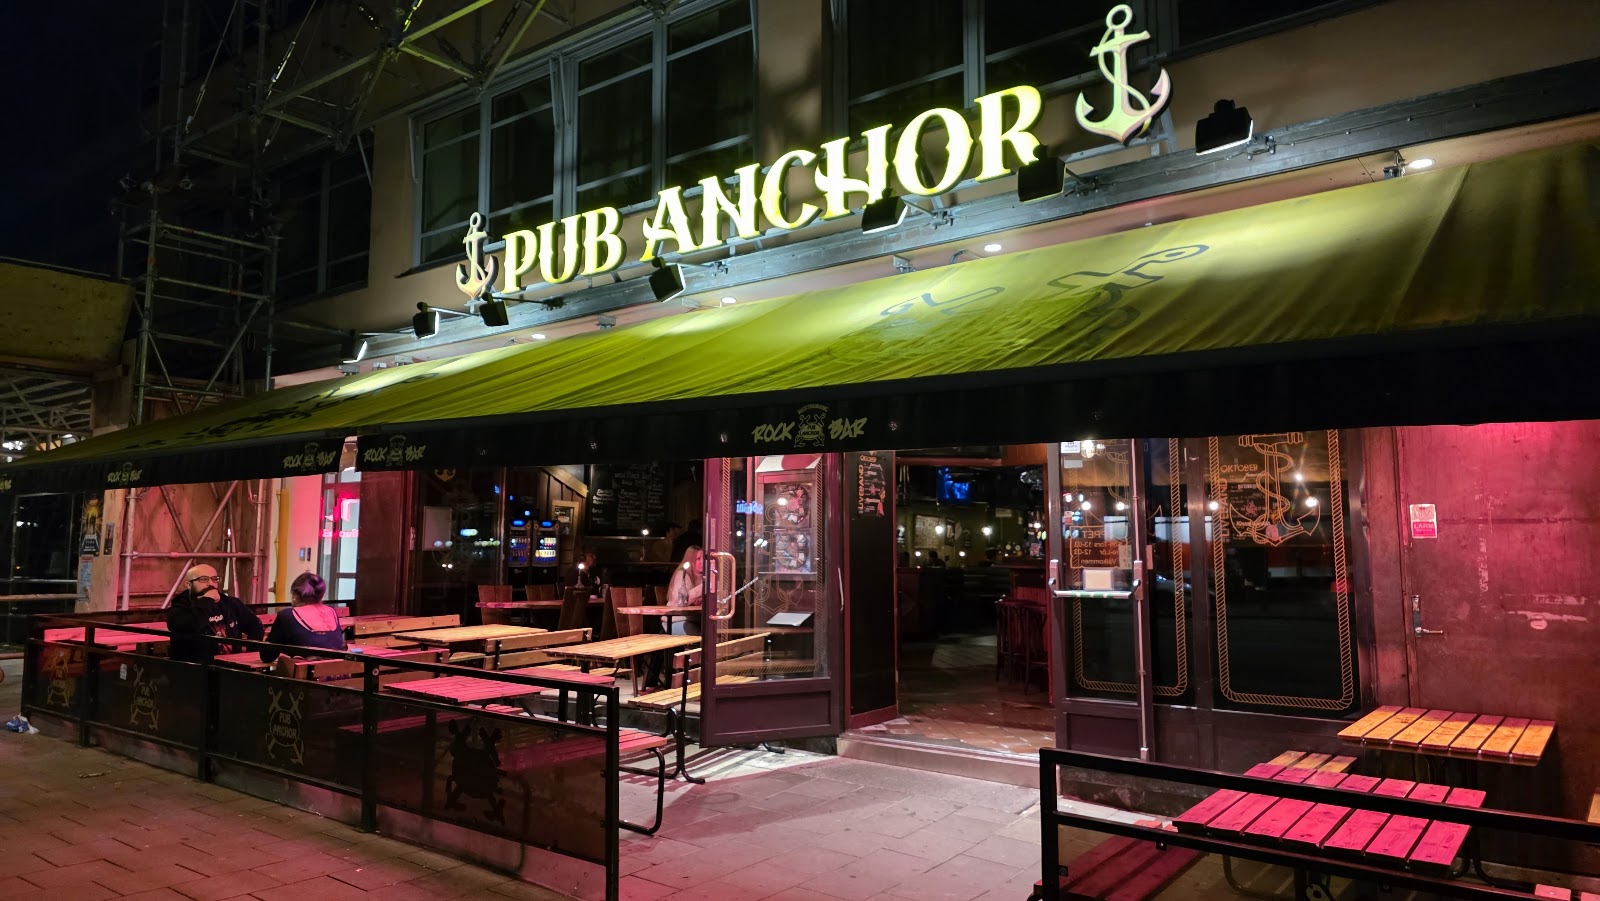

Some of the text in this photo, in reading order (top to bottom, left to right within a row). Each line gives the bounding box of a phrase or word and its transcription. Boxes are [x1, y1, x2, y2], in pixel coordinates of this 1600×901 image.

[501, 84, 1045, 296] PUB ANCHOR
[752, 417, 867, 443] ROCK BAR
[283, 452, 303, 468] ROCK
[363, 447, 388, 462] ROCK
[405, 444, 426, 462] BAR
[1220, 464, 1258, 473] OKTOBER
[279, 711, 291, 725] PUB
[272, 724, 297, 739] ANCHOR
